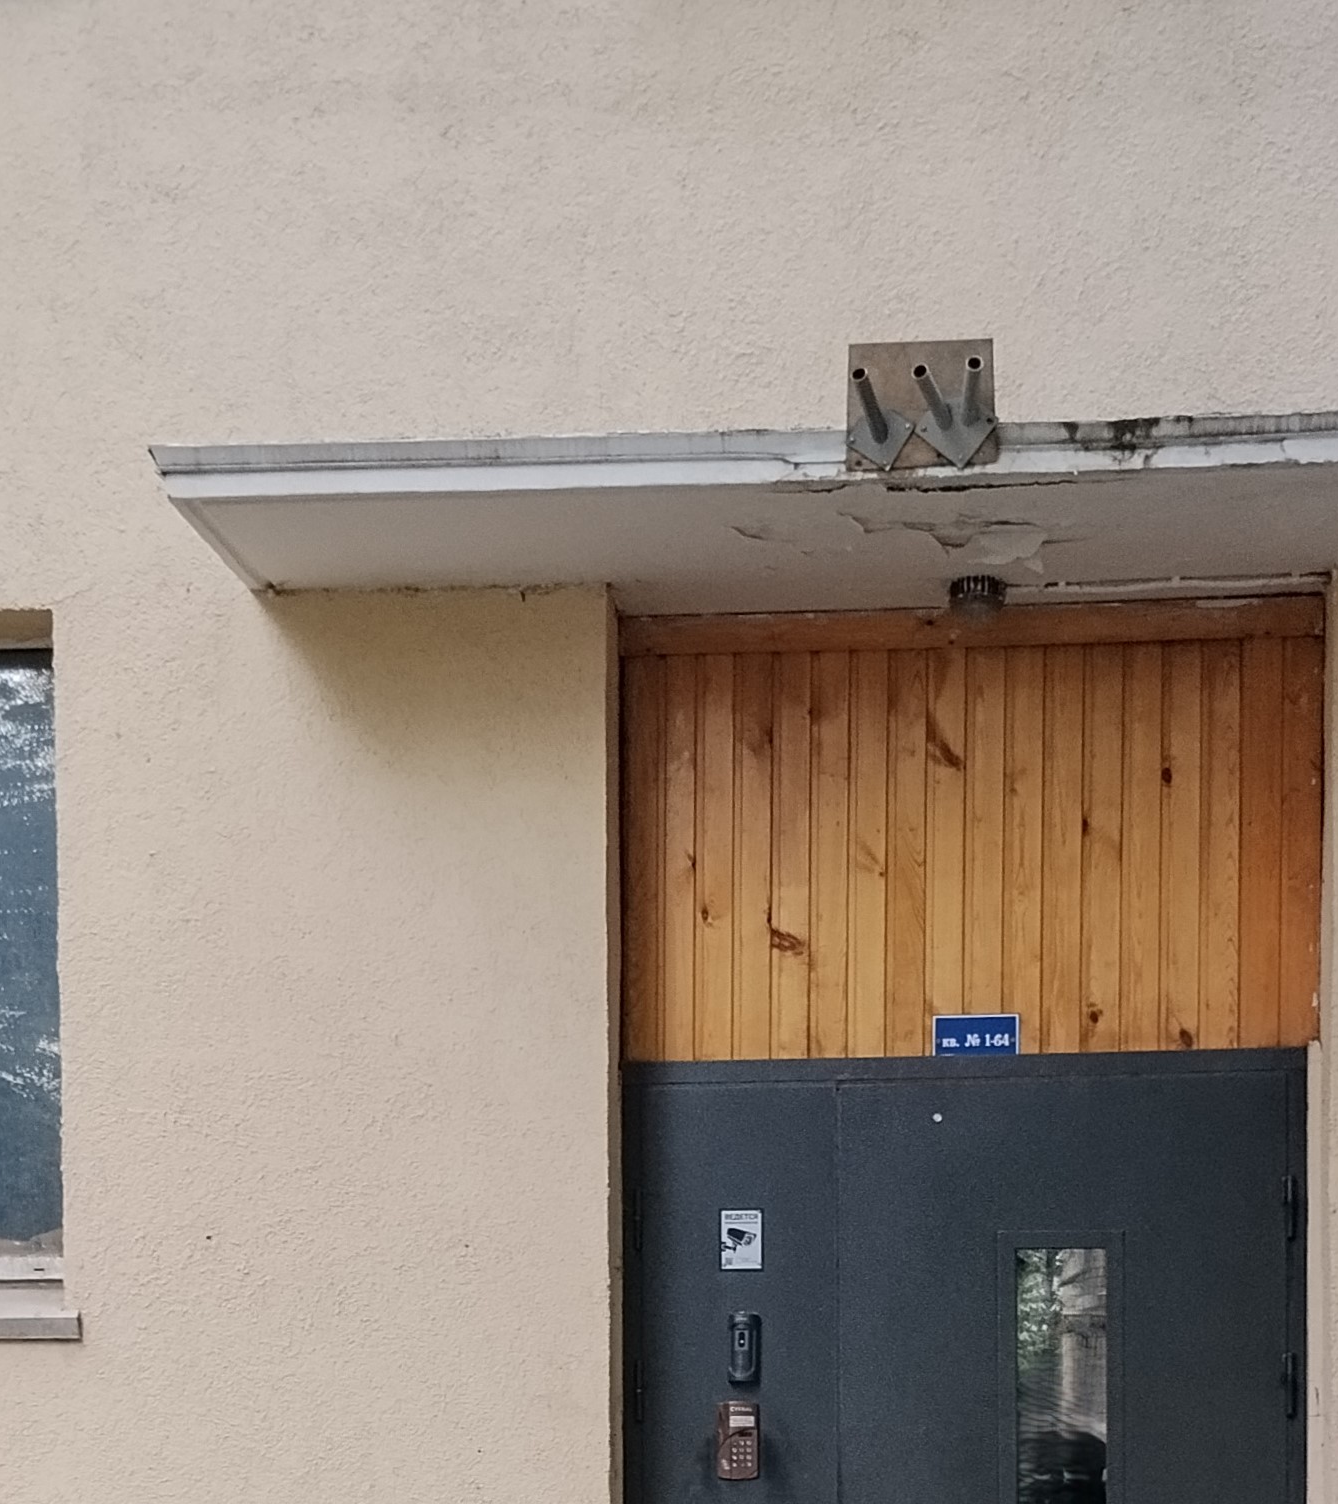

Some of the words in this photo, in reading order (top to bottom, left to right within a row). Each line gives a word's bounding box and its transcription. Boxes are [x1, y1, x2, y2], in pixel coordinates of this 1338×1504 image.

[941, 1037, 960, 1048] кв.
[964, 1033, 981, 1047] №
[984, 1033, 1010, 1047] 1-64
